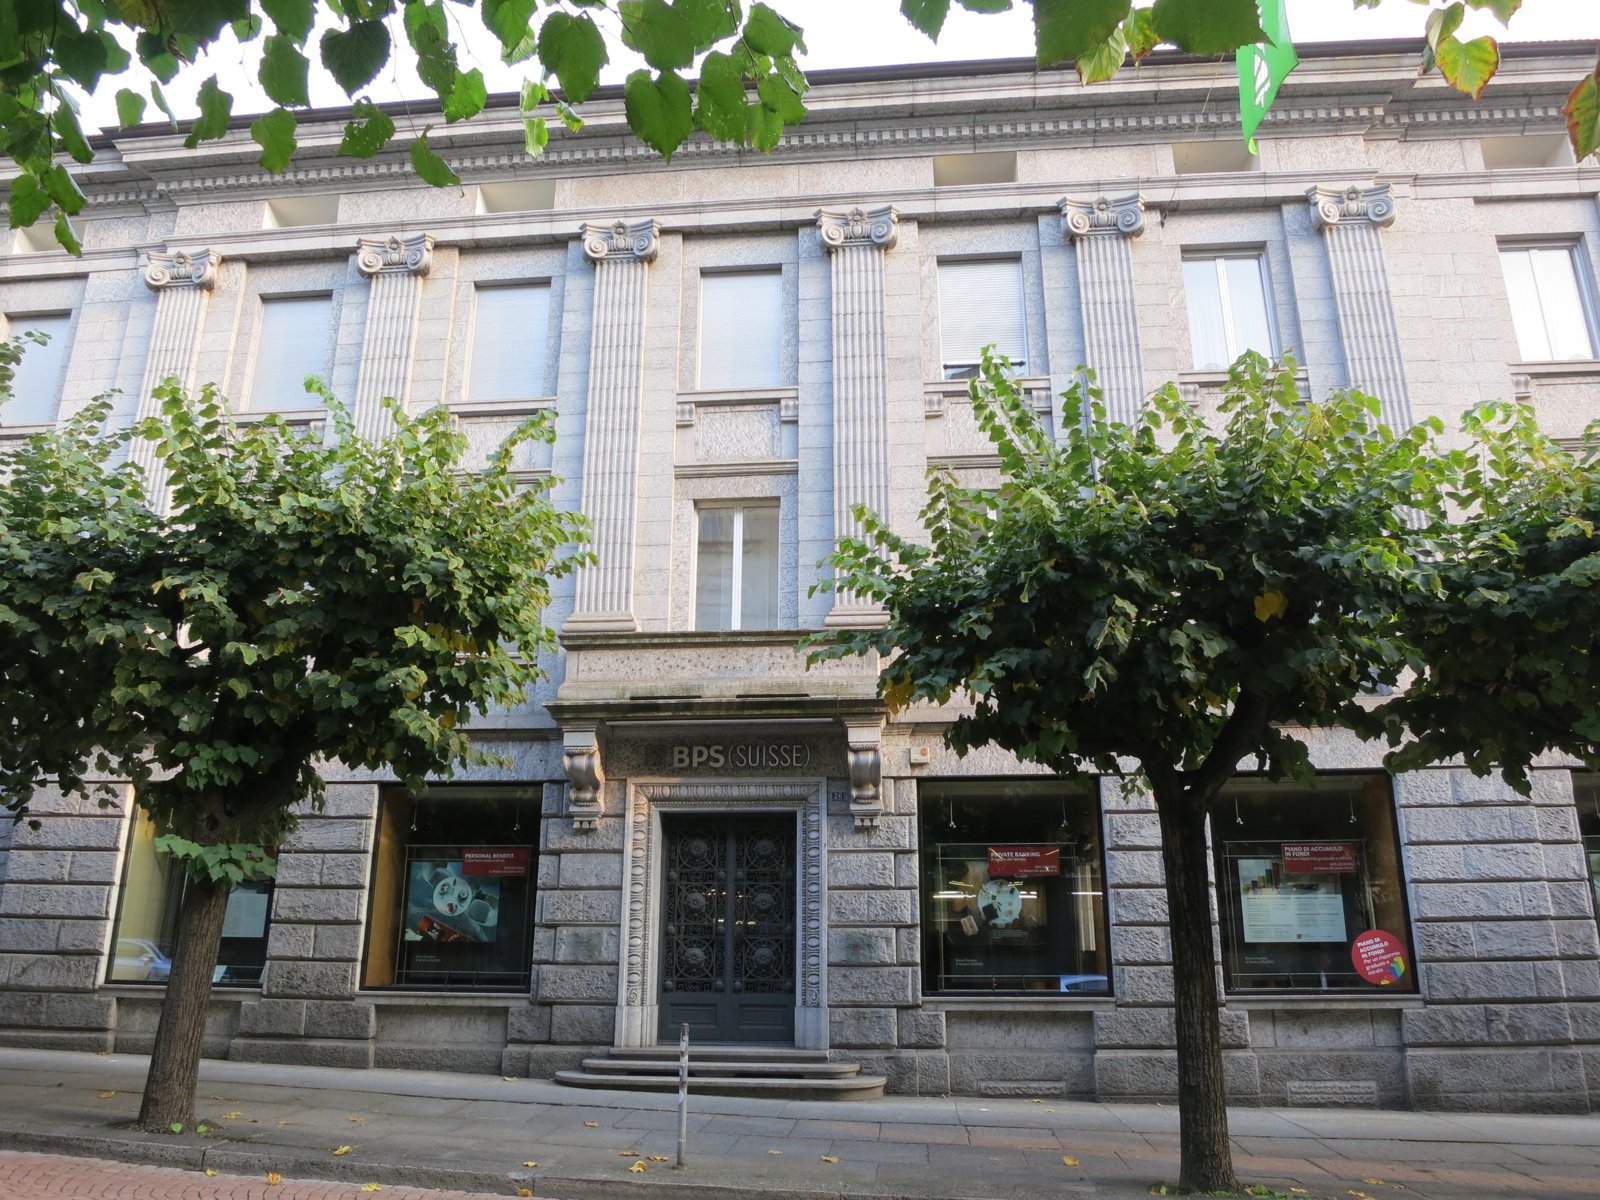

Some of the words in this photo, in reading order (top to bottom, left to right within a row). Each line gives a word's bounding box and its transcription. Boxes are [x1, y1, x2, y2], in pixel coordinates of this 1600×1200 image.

[673, 745, 725, 768] BPS
[728, 744, 810, 769] (SUISSE)
[1359, 941, 1389, 952] ACCUMULO
[1368, 948, 1385, 957] FONDI
